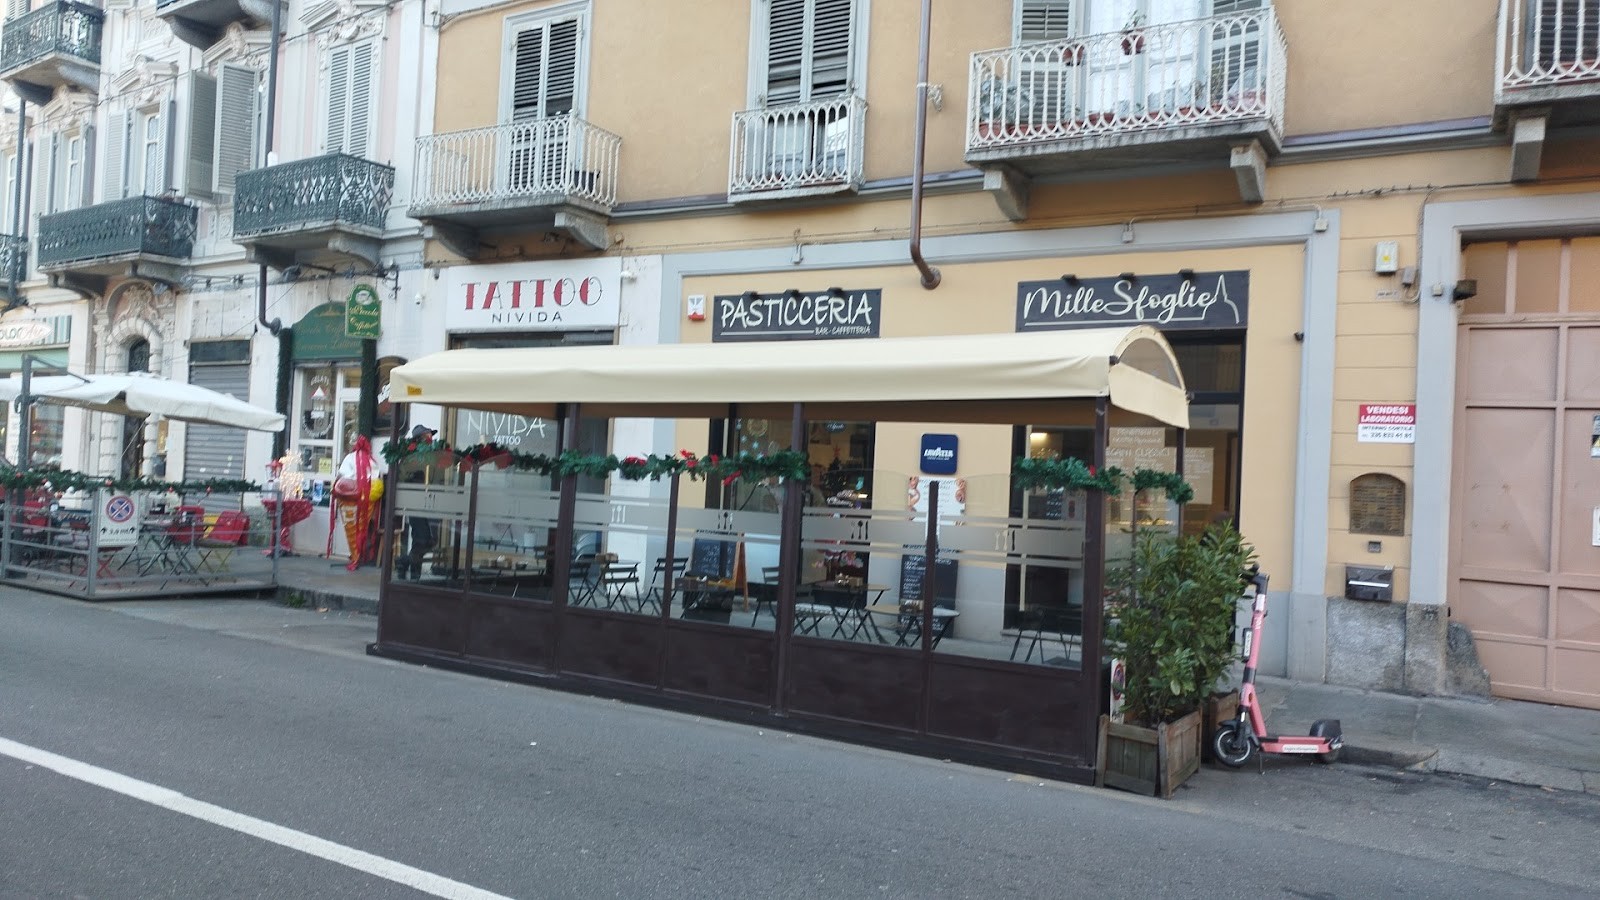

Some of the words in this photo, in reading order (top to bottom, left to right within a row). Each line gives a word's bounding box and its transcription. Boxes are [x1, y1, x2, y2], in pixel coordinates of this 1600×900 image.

[461, 275, 603, 310] TATTOO
[1024, 286, 1104, 319] Mille
[1104, 280, 1214, 324] Sfoglie
[491, 311, 563, 324] NIVIDA
[720, 292, 873, 329] PASTICCERIA
[1360, 415, 1414, 423] LABORATORIO
[1366, 406, 1409, 415] VENDESI
[467, 411, 546, 438] NIVIDA
[493, 434, 522, 446] TATTOO
